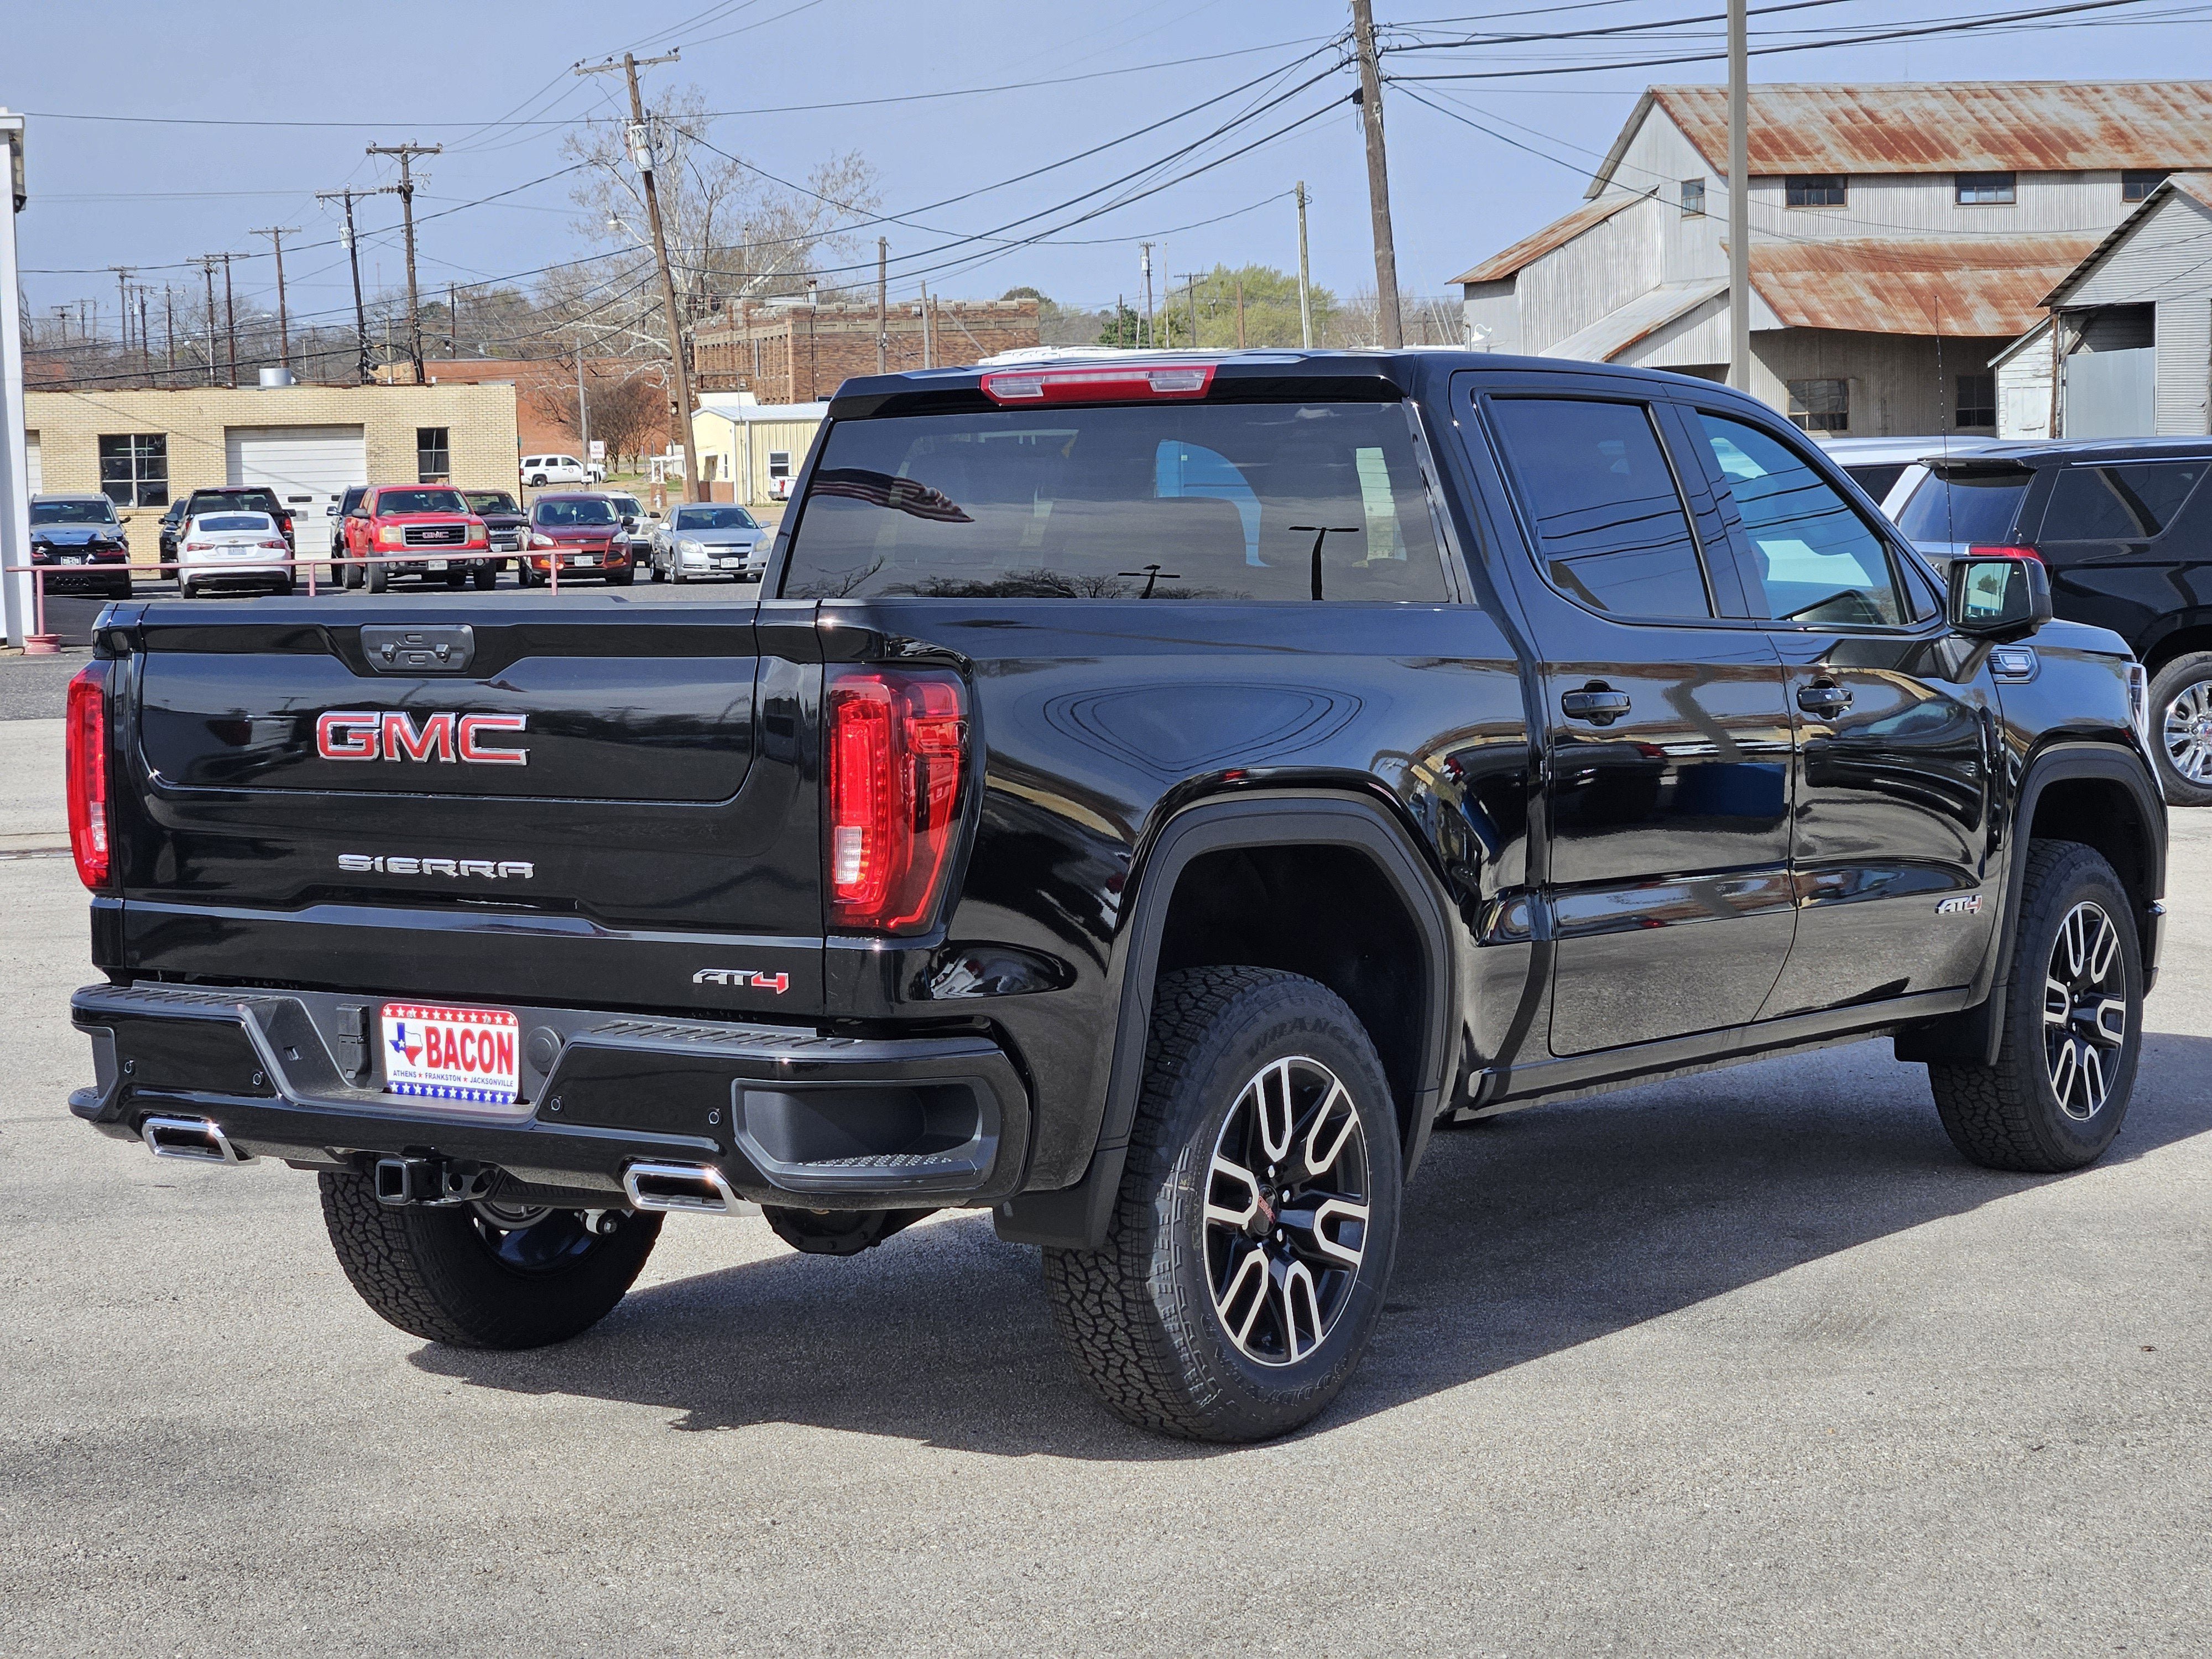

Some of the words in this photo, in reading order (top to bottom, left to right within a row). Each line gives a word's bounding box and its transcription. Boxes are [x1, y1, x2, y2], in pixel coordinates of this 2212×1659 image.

[316, 711, 529, 766] GMC
[338, 854, 535, 879] SIERRA
[1935, 894, 1983, 914] AT4
[692, 968, 789, 995] AT4
[425, 1025, 514, 1075] BACON
[393, 1070, 417, 1078] ATHENS
[425, 1072, 461, 1082] FRANKSTON
[470, 1076, 514, 1087] JACKSONVILLE
[1258, 1196, 1276, 1224] GMC
